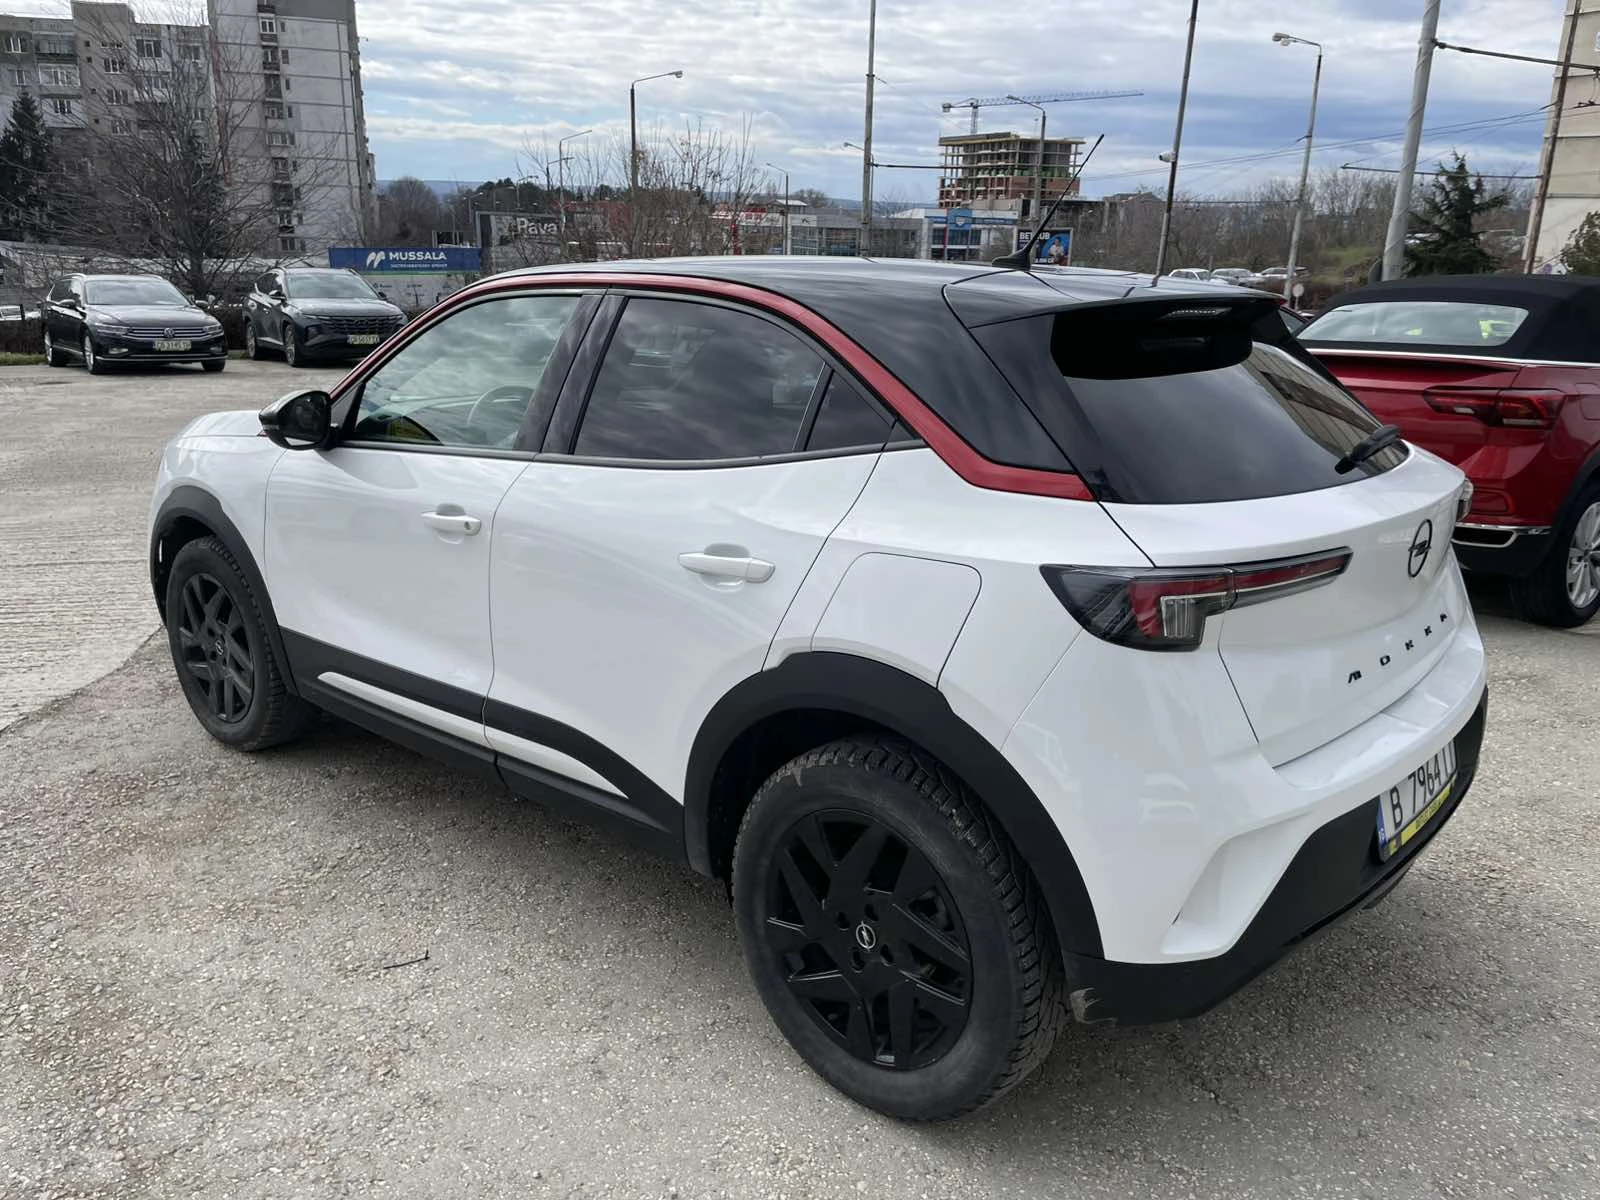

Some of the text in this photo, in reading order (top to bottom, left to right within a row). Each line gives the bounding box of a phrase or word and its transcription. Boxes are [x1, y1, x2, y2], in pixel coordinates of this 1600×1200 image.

[388, 251, 447, 260] MUSSALA
[1347, 613, 1448, 684] MOKKA
[1390, 786, 1403, 830] B
